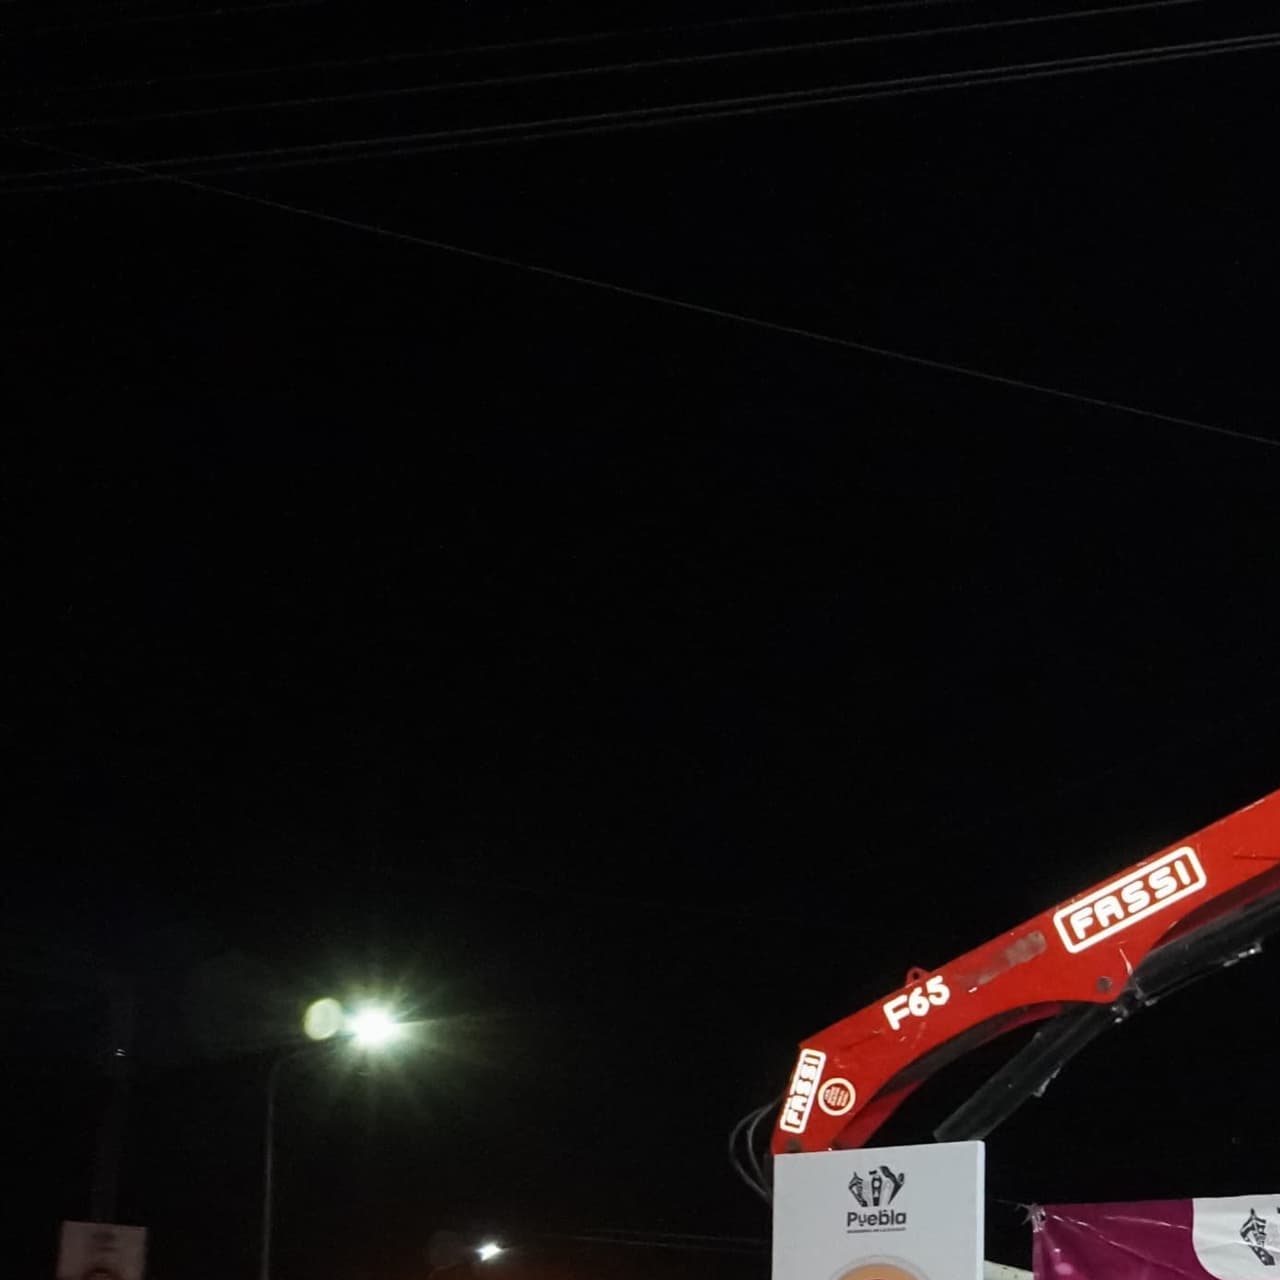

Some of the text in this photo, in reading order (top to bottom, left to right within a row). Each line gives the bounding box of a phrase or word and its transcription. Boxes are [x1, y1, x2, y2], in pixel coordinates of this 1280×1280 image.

[1070, 860, 1191, 939] FASSI
[883, 975, 950, 1030] F65
[785, 1055, 820, 1127] FASSI
[847, 1209, 907, 1227] Puebla
